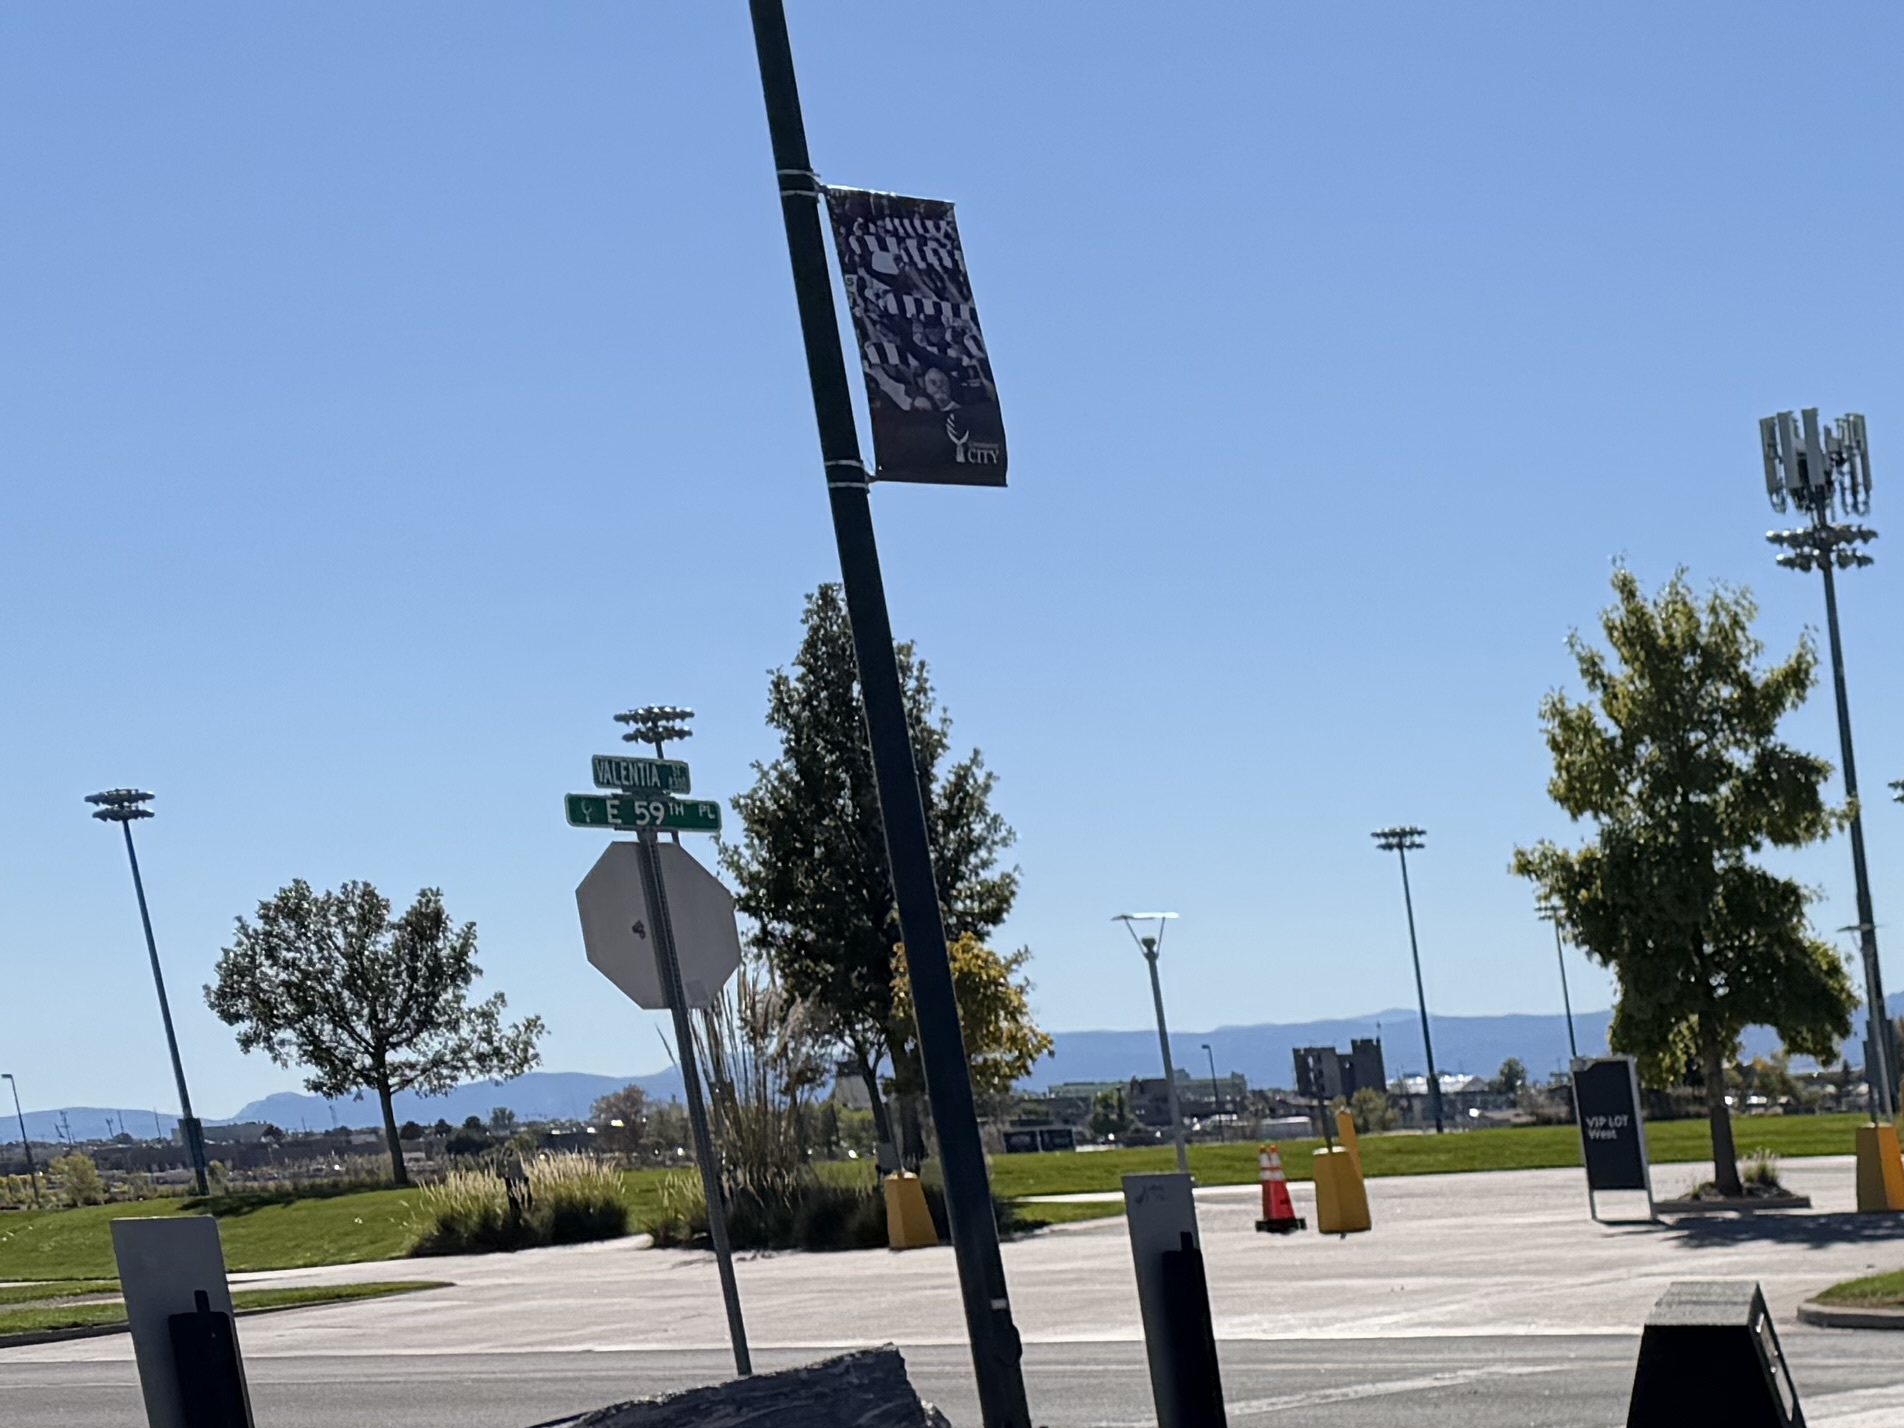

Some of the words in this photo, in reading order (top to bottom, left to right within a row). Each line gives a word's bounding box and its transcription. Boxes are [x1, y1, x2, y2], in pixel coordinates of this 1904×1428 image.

[967, 448, 999, 465] CITY
[595, 758, 660, 787] VALENTIA
[605, 799, 622, 824] E
[698, 804, 716, 819] PL
[1586, 1115, 1606, 1128] VIP
[1608, 1114, 1629, 1128] LOT
[1588, 1129, 1617, 1140] West
